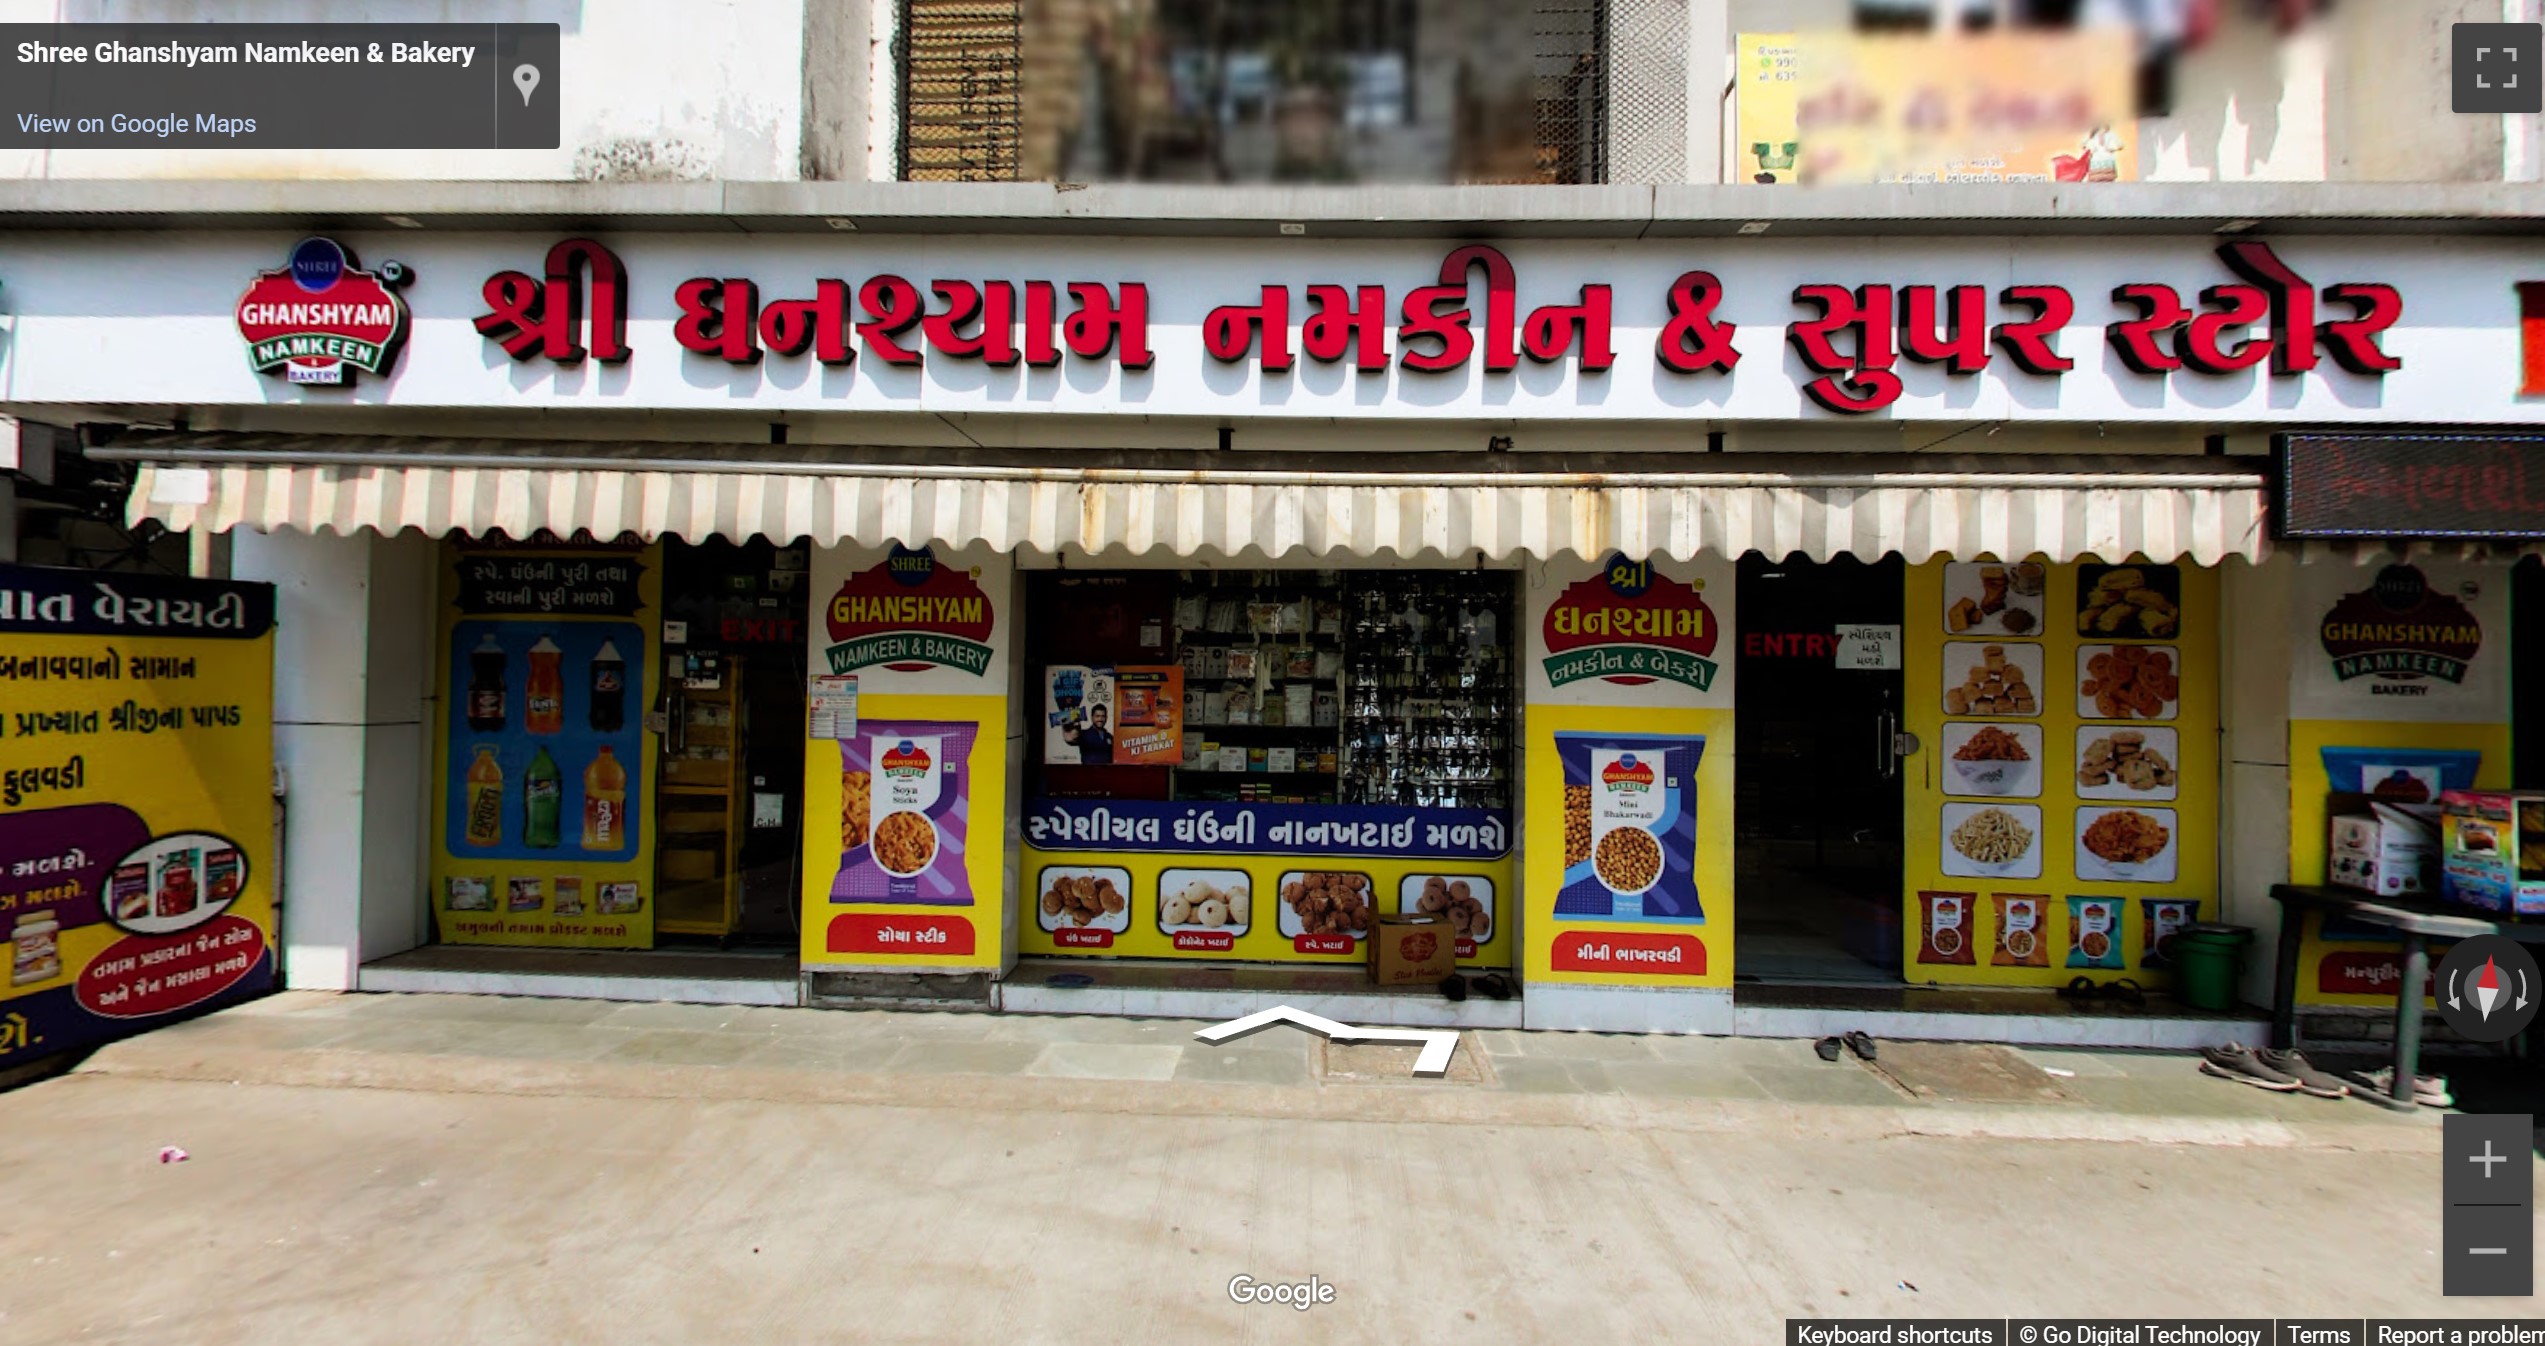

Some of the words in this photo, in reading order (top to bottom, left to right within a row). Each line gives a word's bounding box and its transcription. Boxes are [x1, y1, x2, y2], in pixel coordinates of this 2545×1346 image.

[242, 303, 392, 326] GHANSHYAM
[472, 237, 633, 364] શ્રી
[674, 274, 1154, 370] ઘનશ્યામ
[1203, 244, 1617, 374] નમકીન
[1655, 270, 1742, 374] &
[1787, 283, 2075, 414] સુપર
[2108, 241, 2403, 375] સ્ટોર
[257, 337, 373, 363] NAMKEEN
[289, 371, 339, 381] BAKERY
[891, 556, 931, 571] SHREE
[92, 583, 245, 629] વેરાયટી
[833, 596, 983, 623] GHANSHYAM
[721, 617, 801, 642] EXIT
[1554, 607, 1703, 637] ઘનશ્યામ
[2324, 623, 2479, 644] GHANSHYAM
[834, 638, 907, 670] NAMKEEN
[911, 637, 921, 655] &
[925, 639, 987, 670] BAKERY
[1744, 631, 1843, 658] ENTRY
[1551, 650, 1624, 681] નમકીન
[1629, 652, 1644, 669] &
[1650, 650, 1706, 687] બેકરી
[2340, 654, 2457, 678] NAMKEEN
[2371, 684, 2428, 696] BAKERY
[190, 705, 241, 727] પાપડ
[1122, 733, 1158, 749] VITAMIN
[1142, 739, 1175, 754] TAAKAT
[1029, 805, 1160, 842] સ્પેશીયલ
[1268, 816, 1415, 848] નાનખટાઈ
[1426, 815, 1505, 850] મળશે
